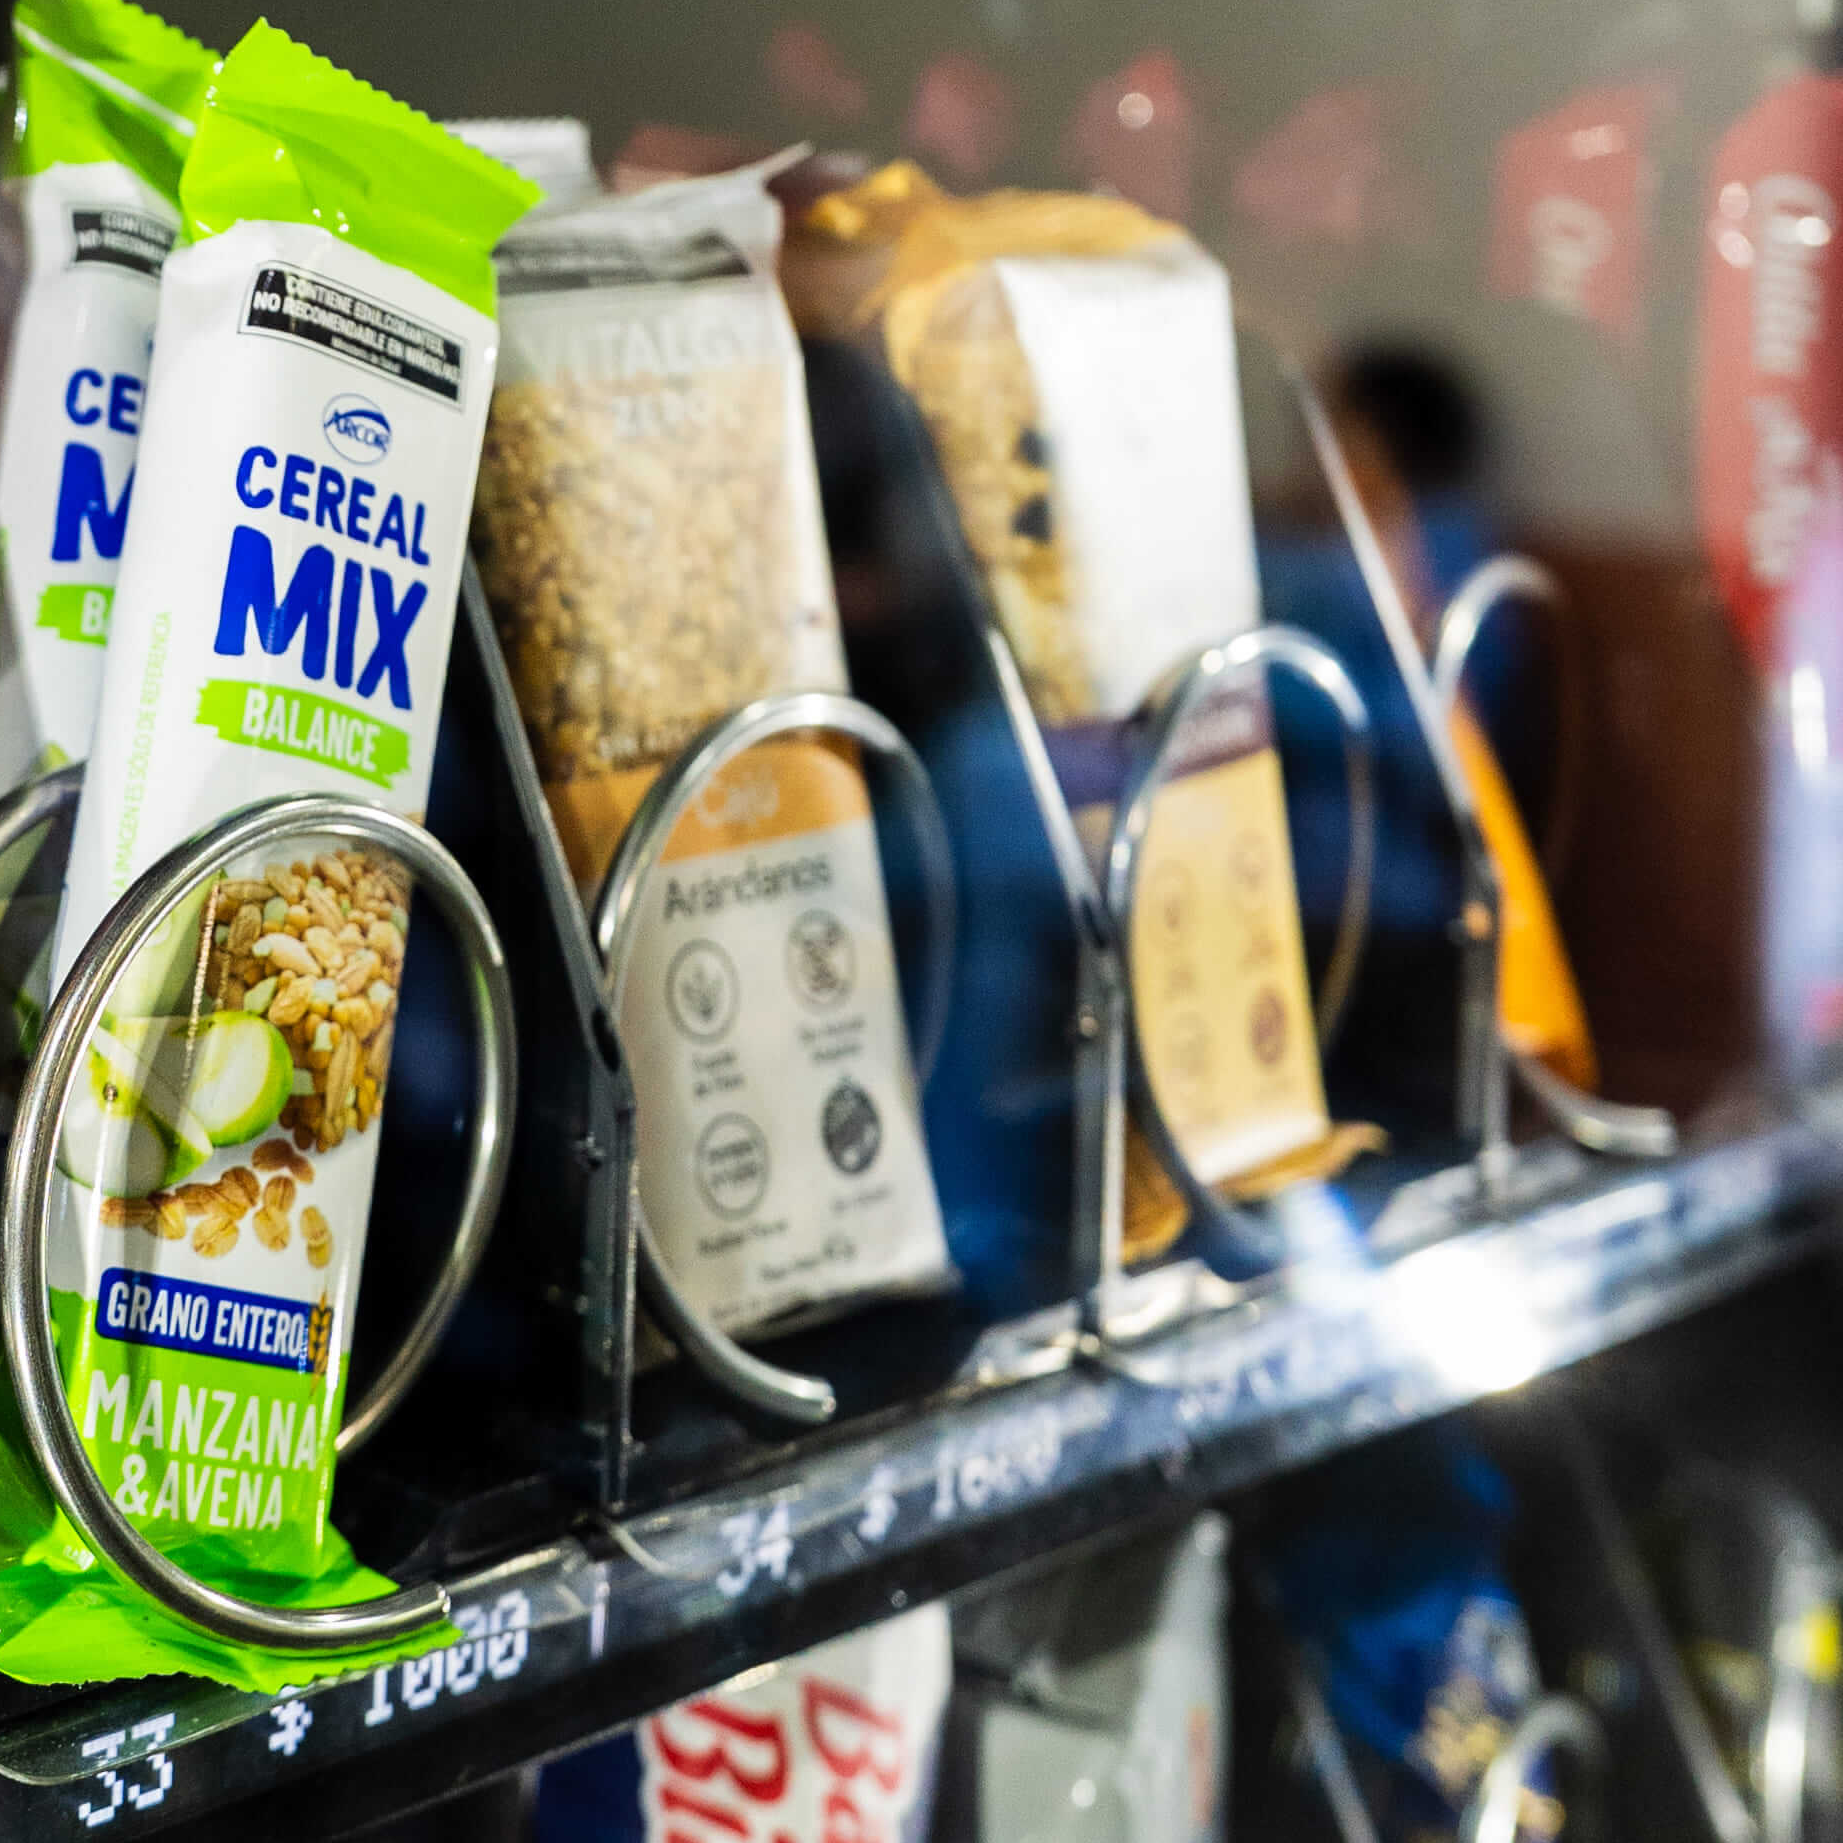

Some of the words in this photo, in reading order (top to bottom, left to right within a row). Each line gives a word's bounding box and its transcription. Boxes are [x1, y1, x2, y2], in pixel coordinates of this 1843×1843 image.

[253, 291, 281, 313] NO
[235, 444, 430, 568] CEREAL
[213, 524, 428, 710] MIX
[242, 687, 383, 773] BALANCE
[106, 1278, 207, 1339] GRANO
[212, 1295, 306, 1360] ENTERO
[82, 1371, 318, 1472] MANZANA
[78, 1712, 176, 1828] 33
[364, 1591, 529, 1726] 1000
